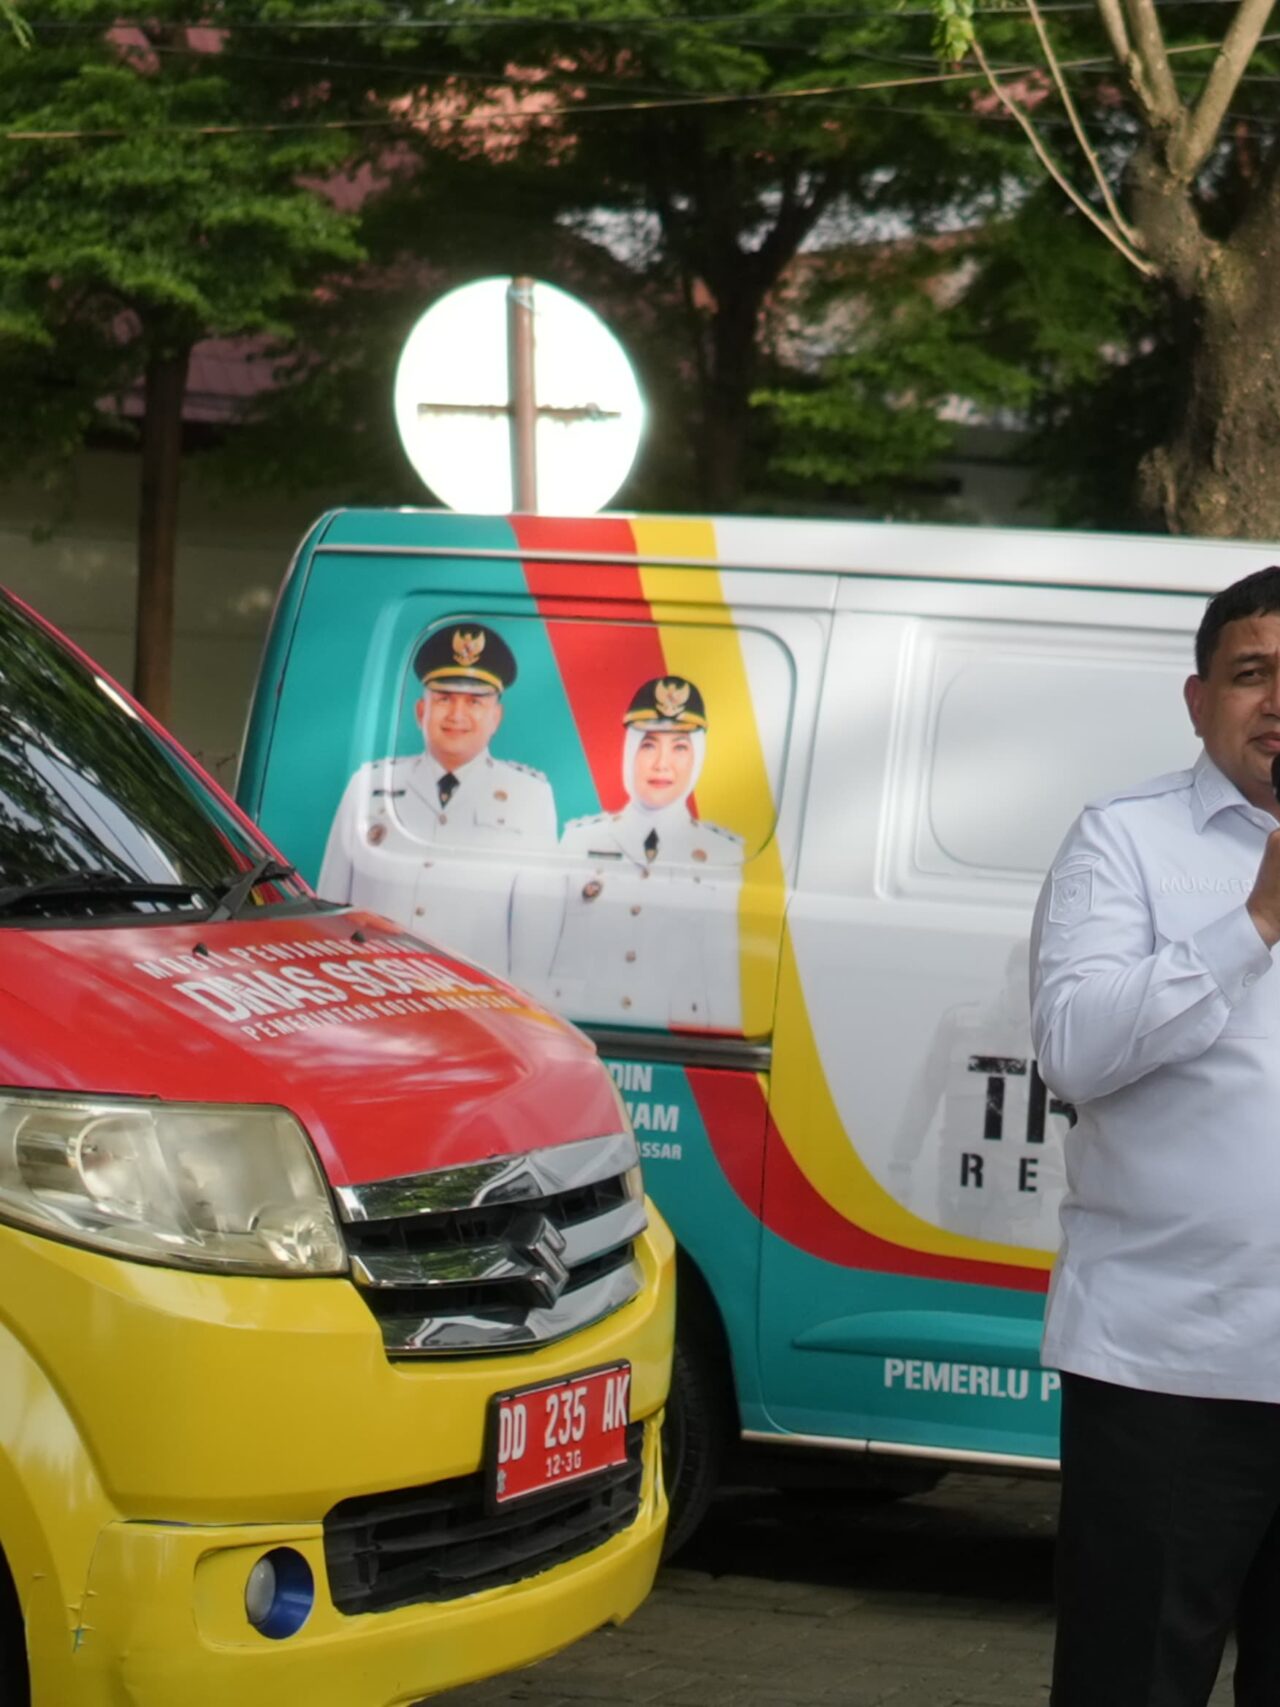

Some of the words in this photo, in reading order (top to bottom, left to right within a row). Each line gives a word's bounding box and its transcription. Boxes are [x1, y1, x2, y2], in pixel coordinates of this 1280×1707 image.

[133, 950, 240, 980] MOBIL
[171, 965, 348, 1023] DINAS
[319, 957, 496, 998] SOSIAL
[240, 1003, 380, 1042] PEMERINTAH
[371, 998, 431, 1017] KOTA
[637, 1141, 682, 1160] SSAR
[960, 1152, 1039, 1192] RE
[883, 1356, 1030, 1401] PEMERLU
[498, 1403, 527, 1464] DD
[544, 1386, 588, 1449] 235
[602, 1374, 630, 1433] AK
